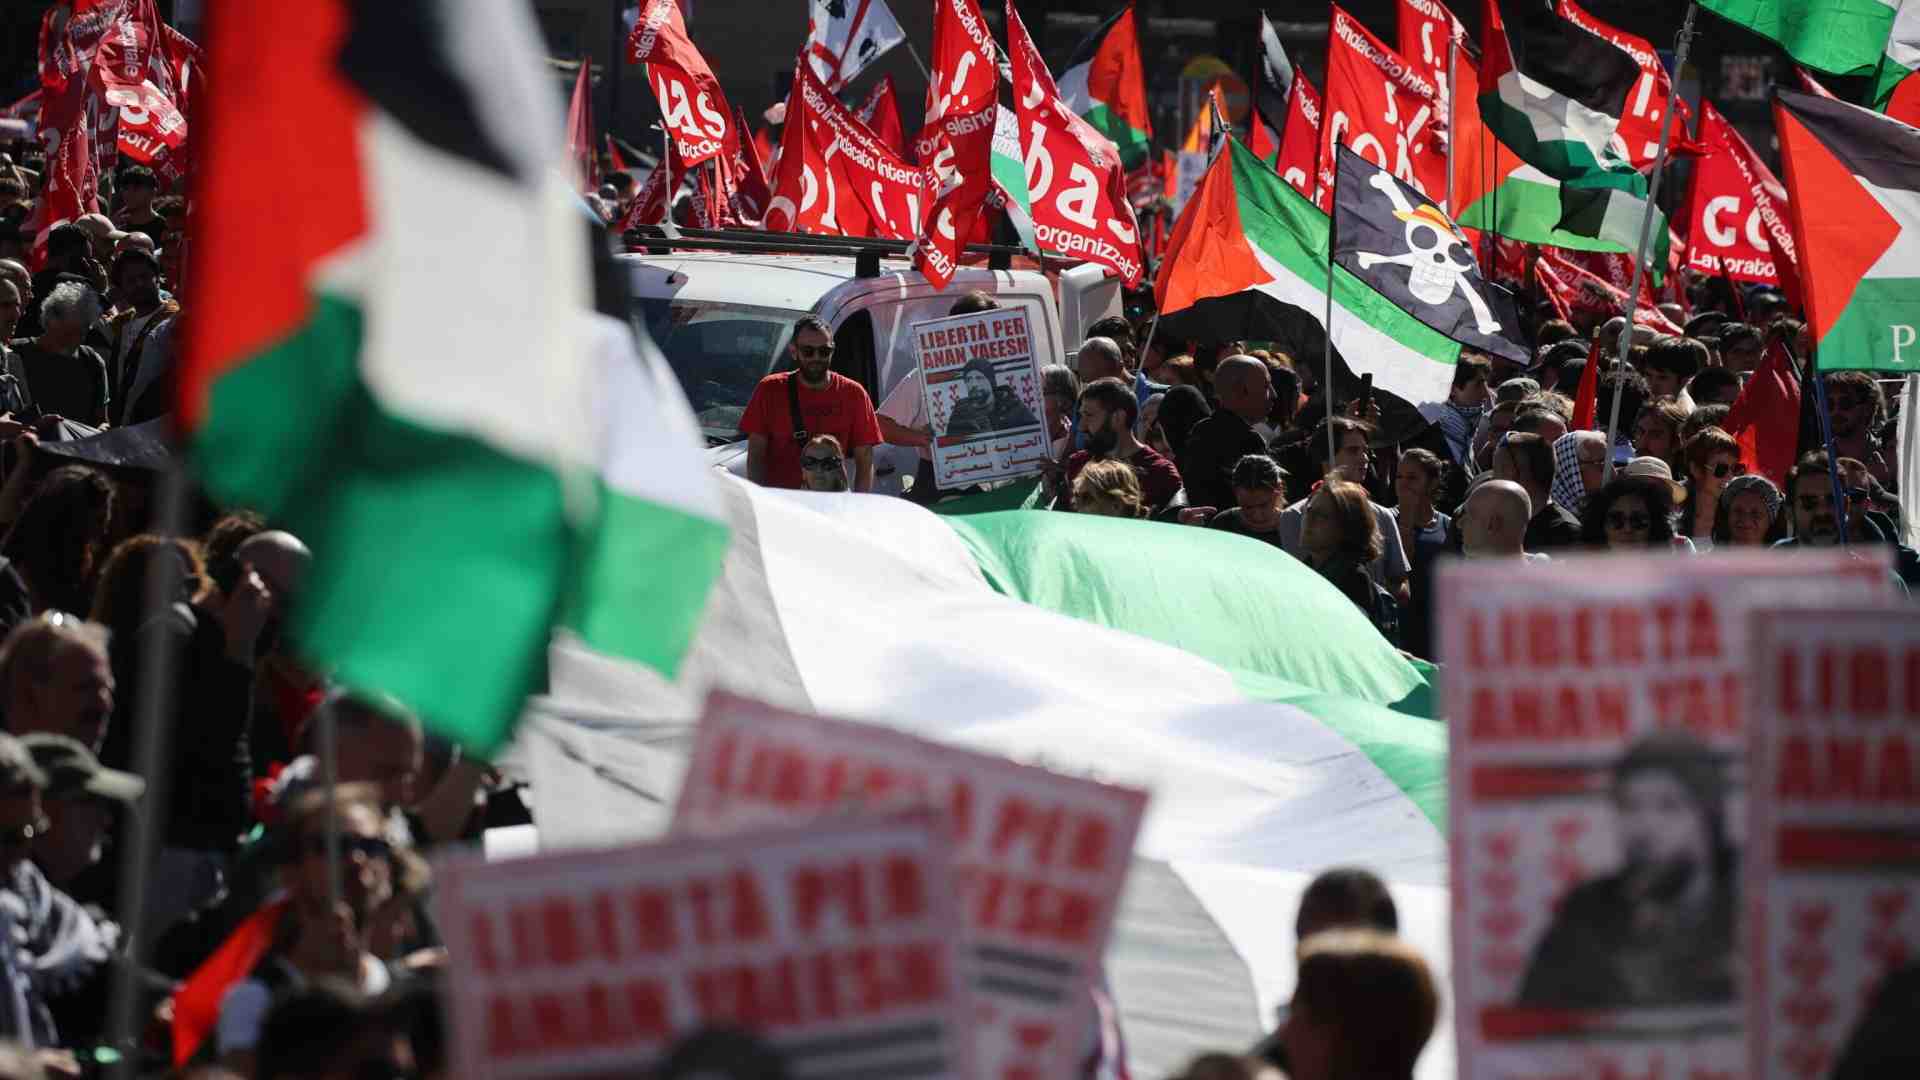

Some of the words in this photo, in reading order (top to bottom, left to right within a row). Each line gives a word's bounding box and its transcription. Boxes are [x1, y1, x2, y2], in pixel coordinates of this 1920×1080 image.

[993, 317, 1025, 338] PER
[922, 346, 967, 369] ANAN
[969, 336, 1029, 359] YAEESH
[1776, 734, 1915, 804] ANA
